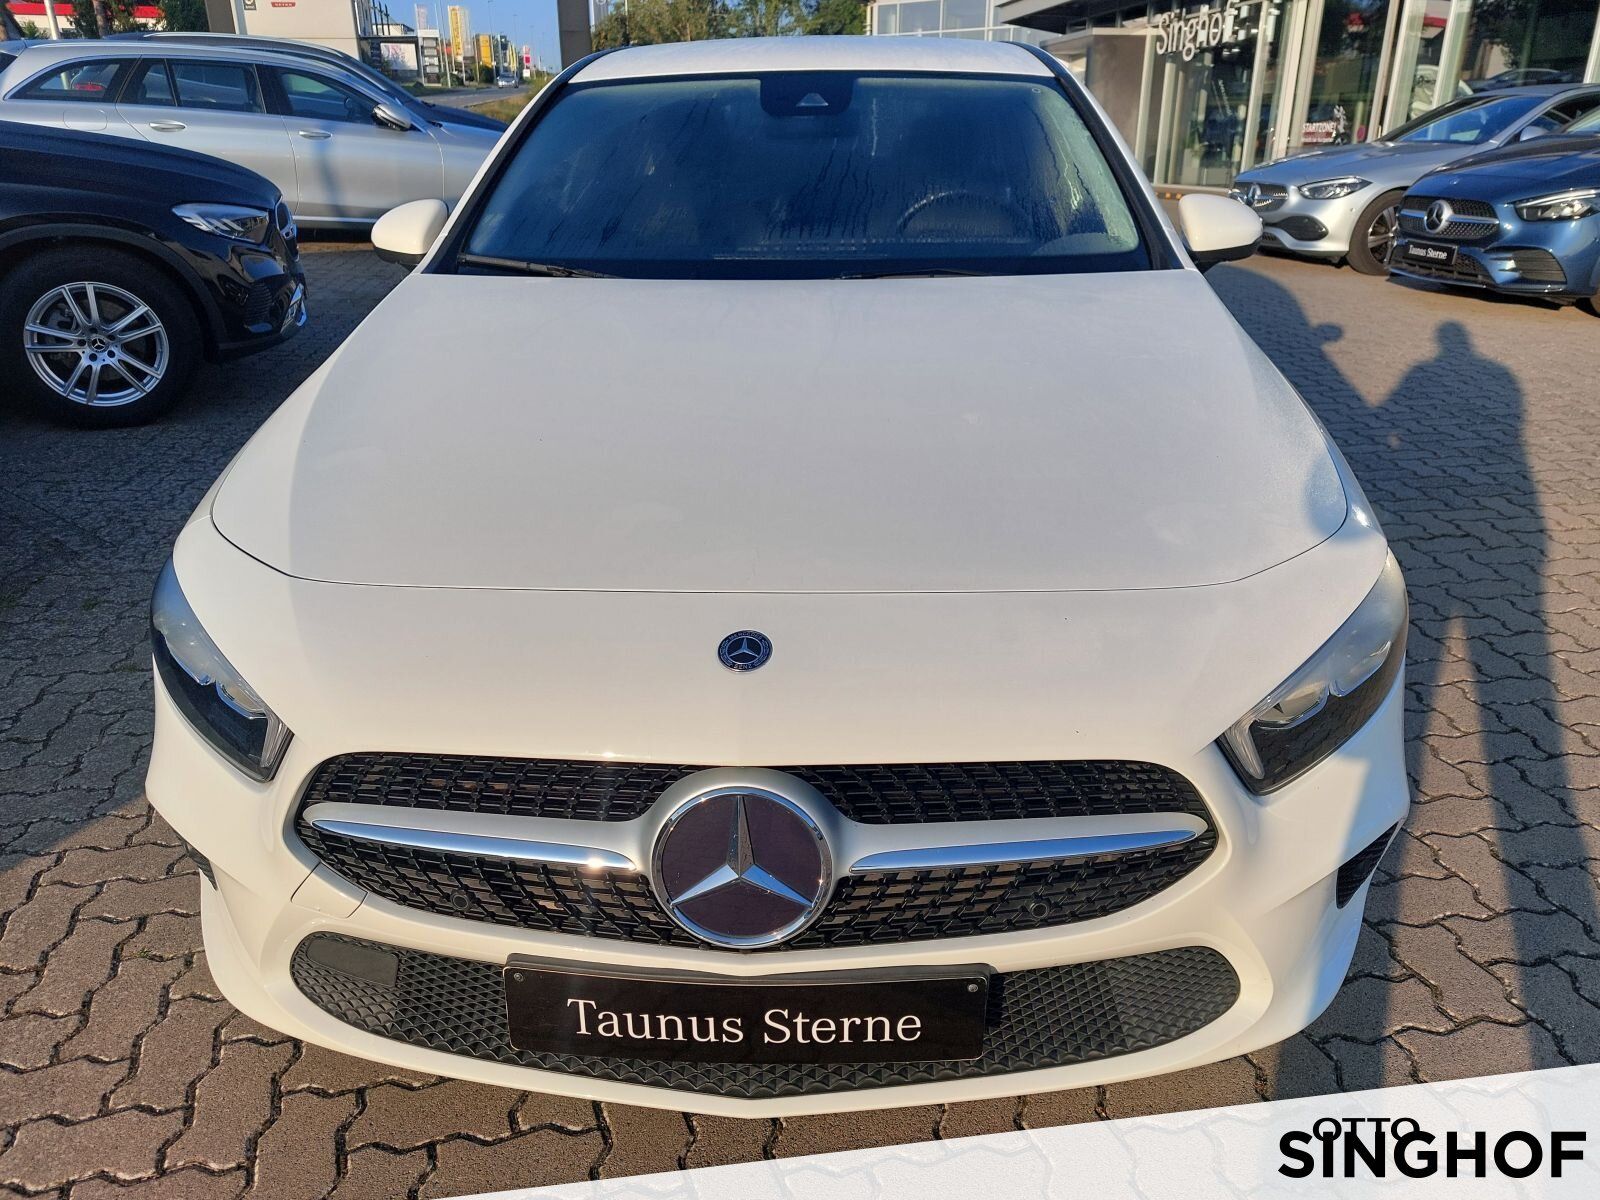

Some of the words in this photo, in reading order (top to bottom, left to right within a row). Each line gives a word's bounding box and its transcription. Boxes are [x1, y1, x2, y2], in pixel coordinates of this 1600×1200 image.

[1156, 0, 1238, 61] Singhof
[1408, 245, 1426, 257] Taunus
[1427, 248, 1447, 259] Sterne
[566, 998, 744, 1043] Taunus
[763, 1008, 922, 1045] Sterne
